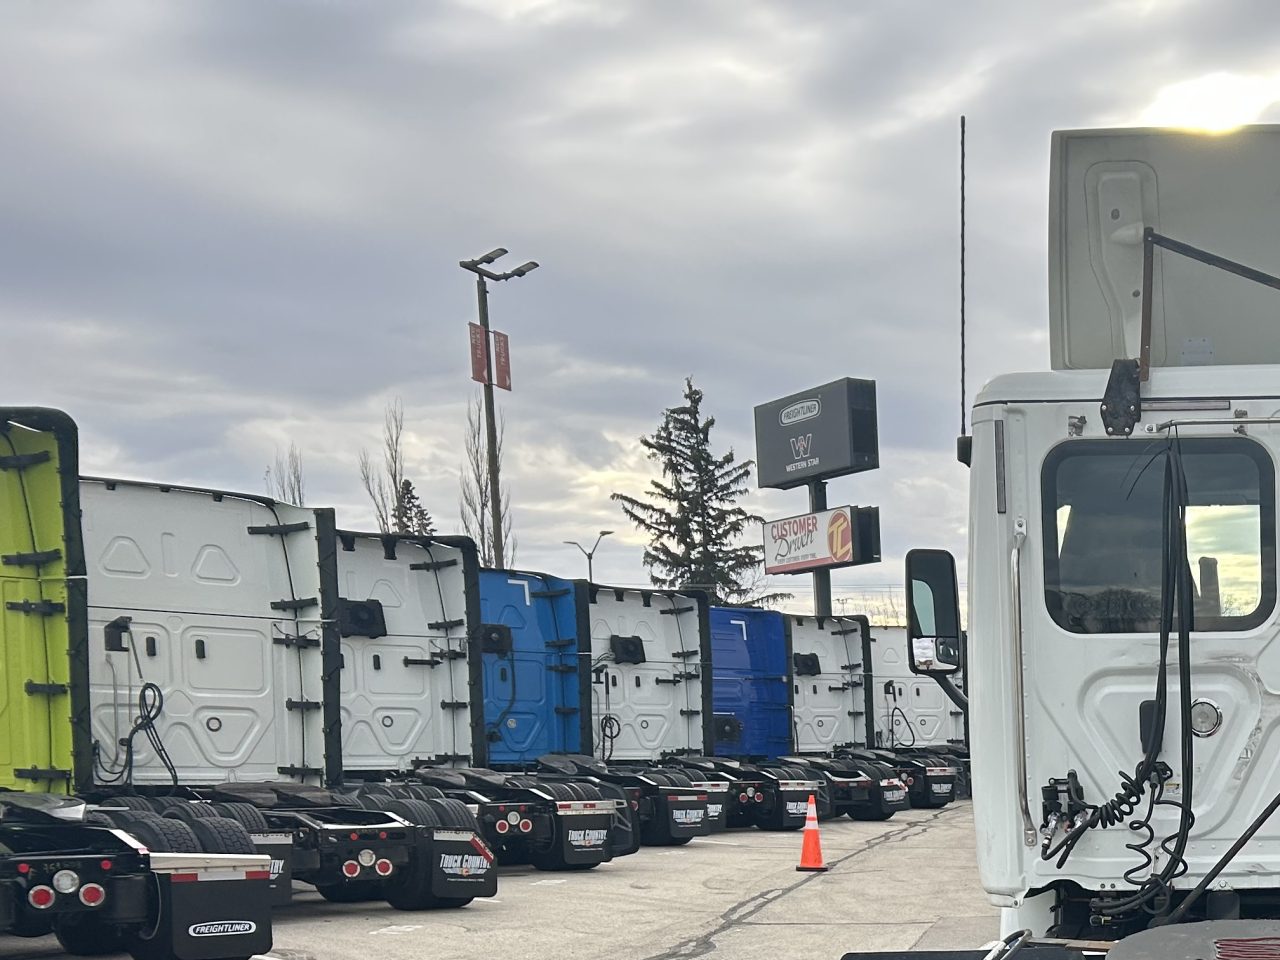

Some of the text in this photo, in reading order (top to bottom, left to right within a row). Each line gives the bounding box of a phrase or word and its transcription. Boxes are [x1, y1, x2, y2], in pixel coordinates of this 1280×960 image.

[783, 403, 817, 421] FREIGHTLINER
[785, 457, 820, 473] WESTERN STAR
[771, 515, 818, 541] CUSTOMER
[439, 853, 462, 869] TRUCK
[195, 923, 250, 935] FREIGHTLINER
